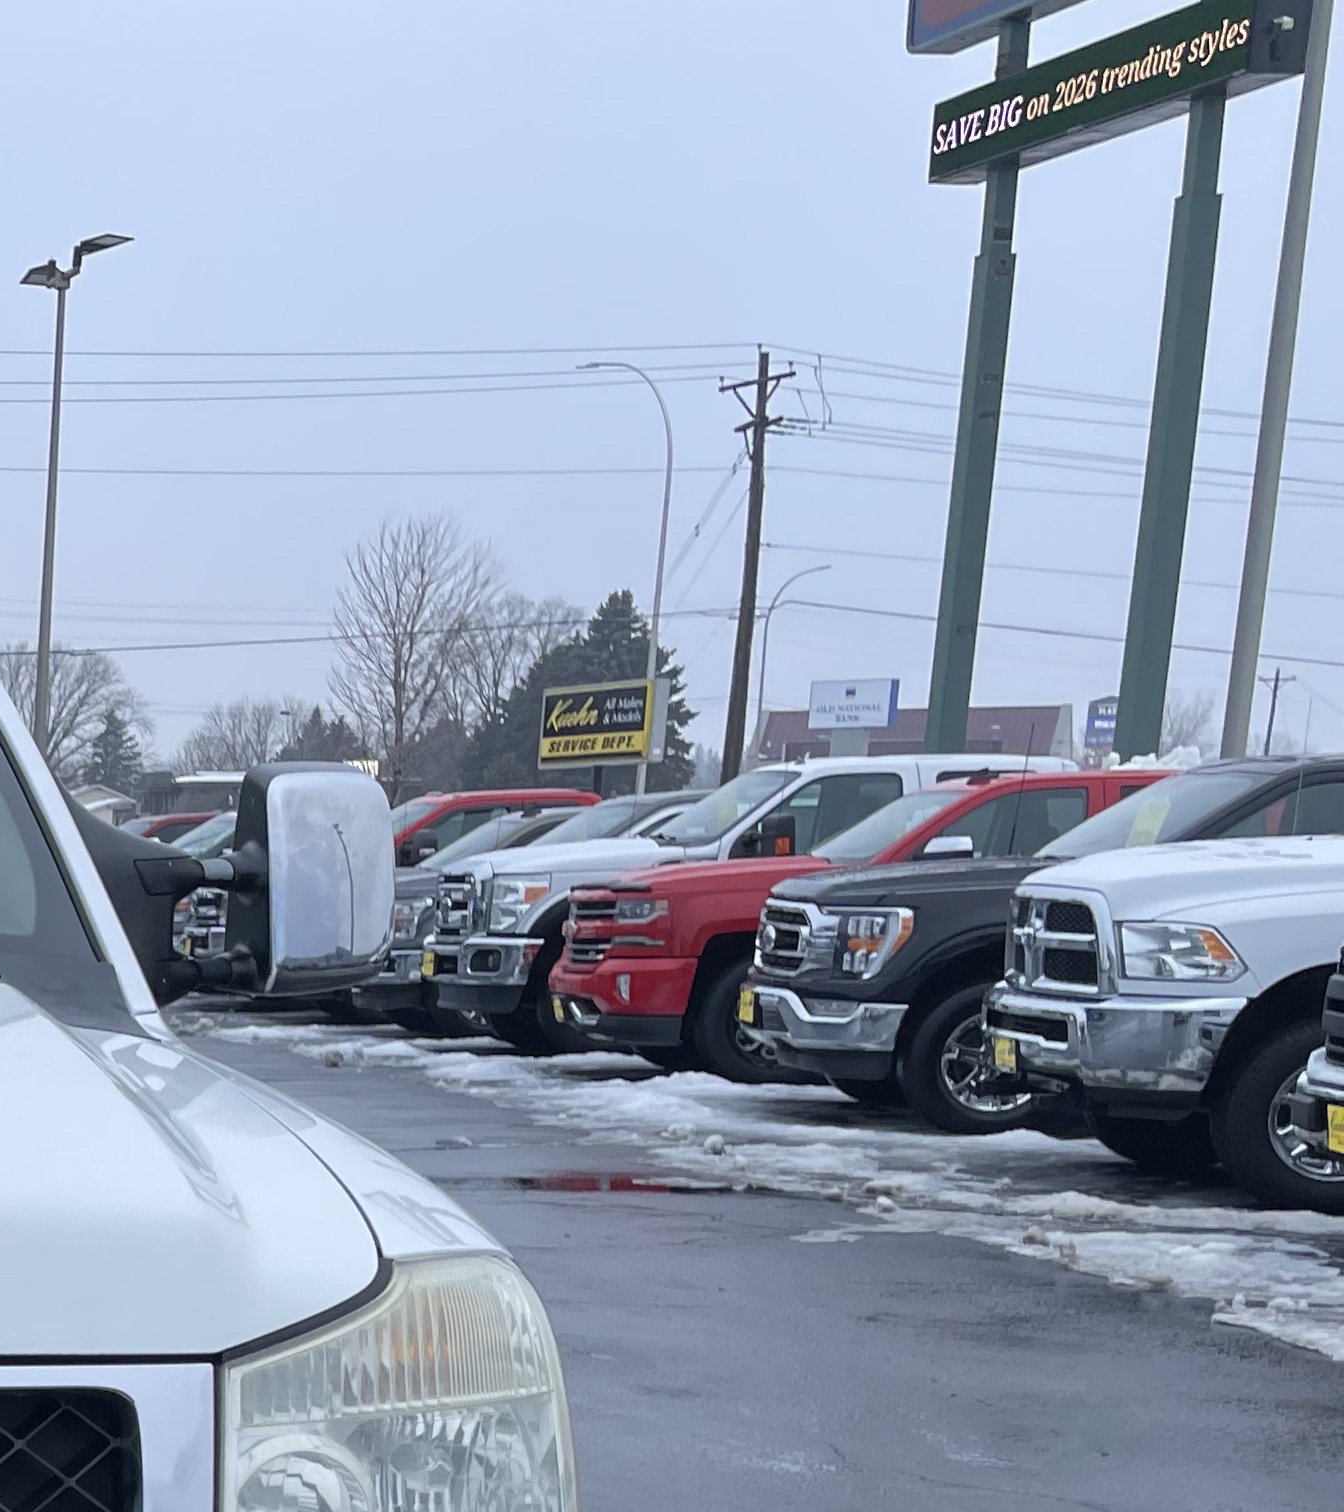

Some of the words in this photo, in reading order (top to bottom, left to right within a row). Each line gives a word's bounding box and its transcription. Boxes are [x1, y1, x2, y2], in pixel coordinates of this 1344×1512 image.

[933, 112, 984, 155] SAVE
[985, 95, 1024, 139] BIG
[1026, 90, 1050, 122] on
[1053, 68, 1099, 112] 2026
[1100, 39, 1186, 96] trending
[1187, 17, 1251, 68] styles
[546, 696, 599, 732] Kuehn
[838, 703, 881, 713] NATIONAL
[548, 738, 599, 753] SERVICE
[601, 735, 635, 750] DEPT.
